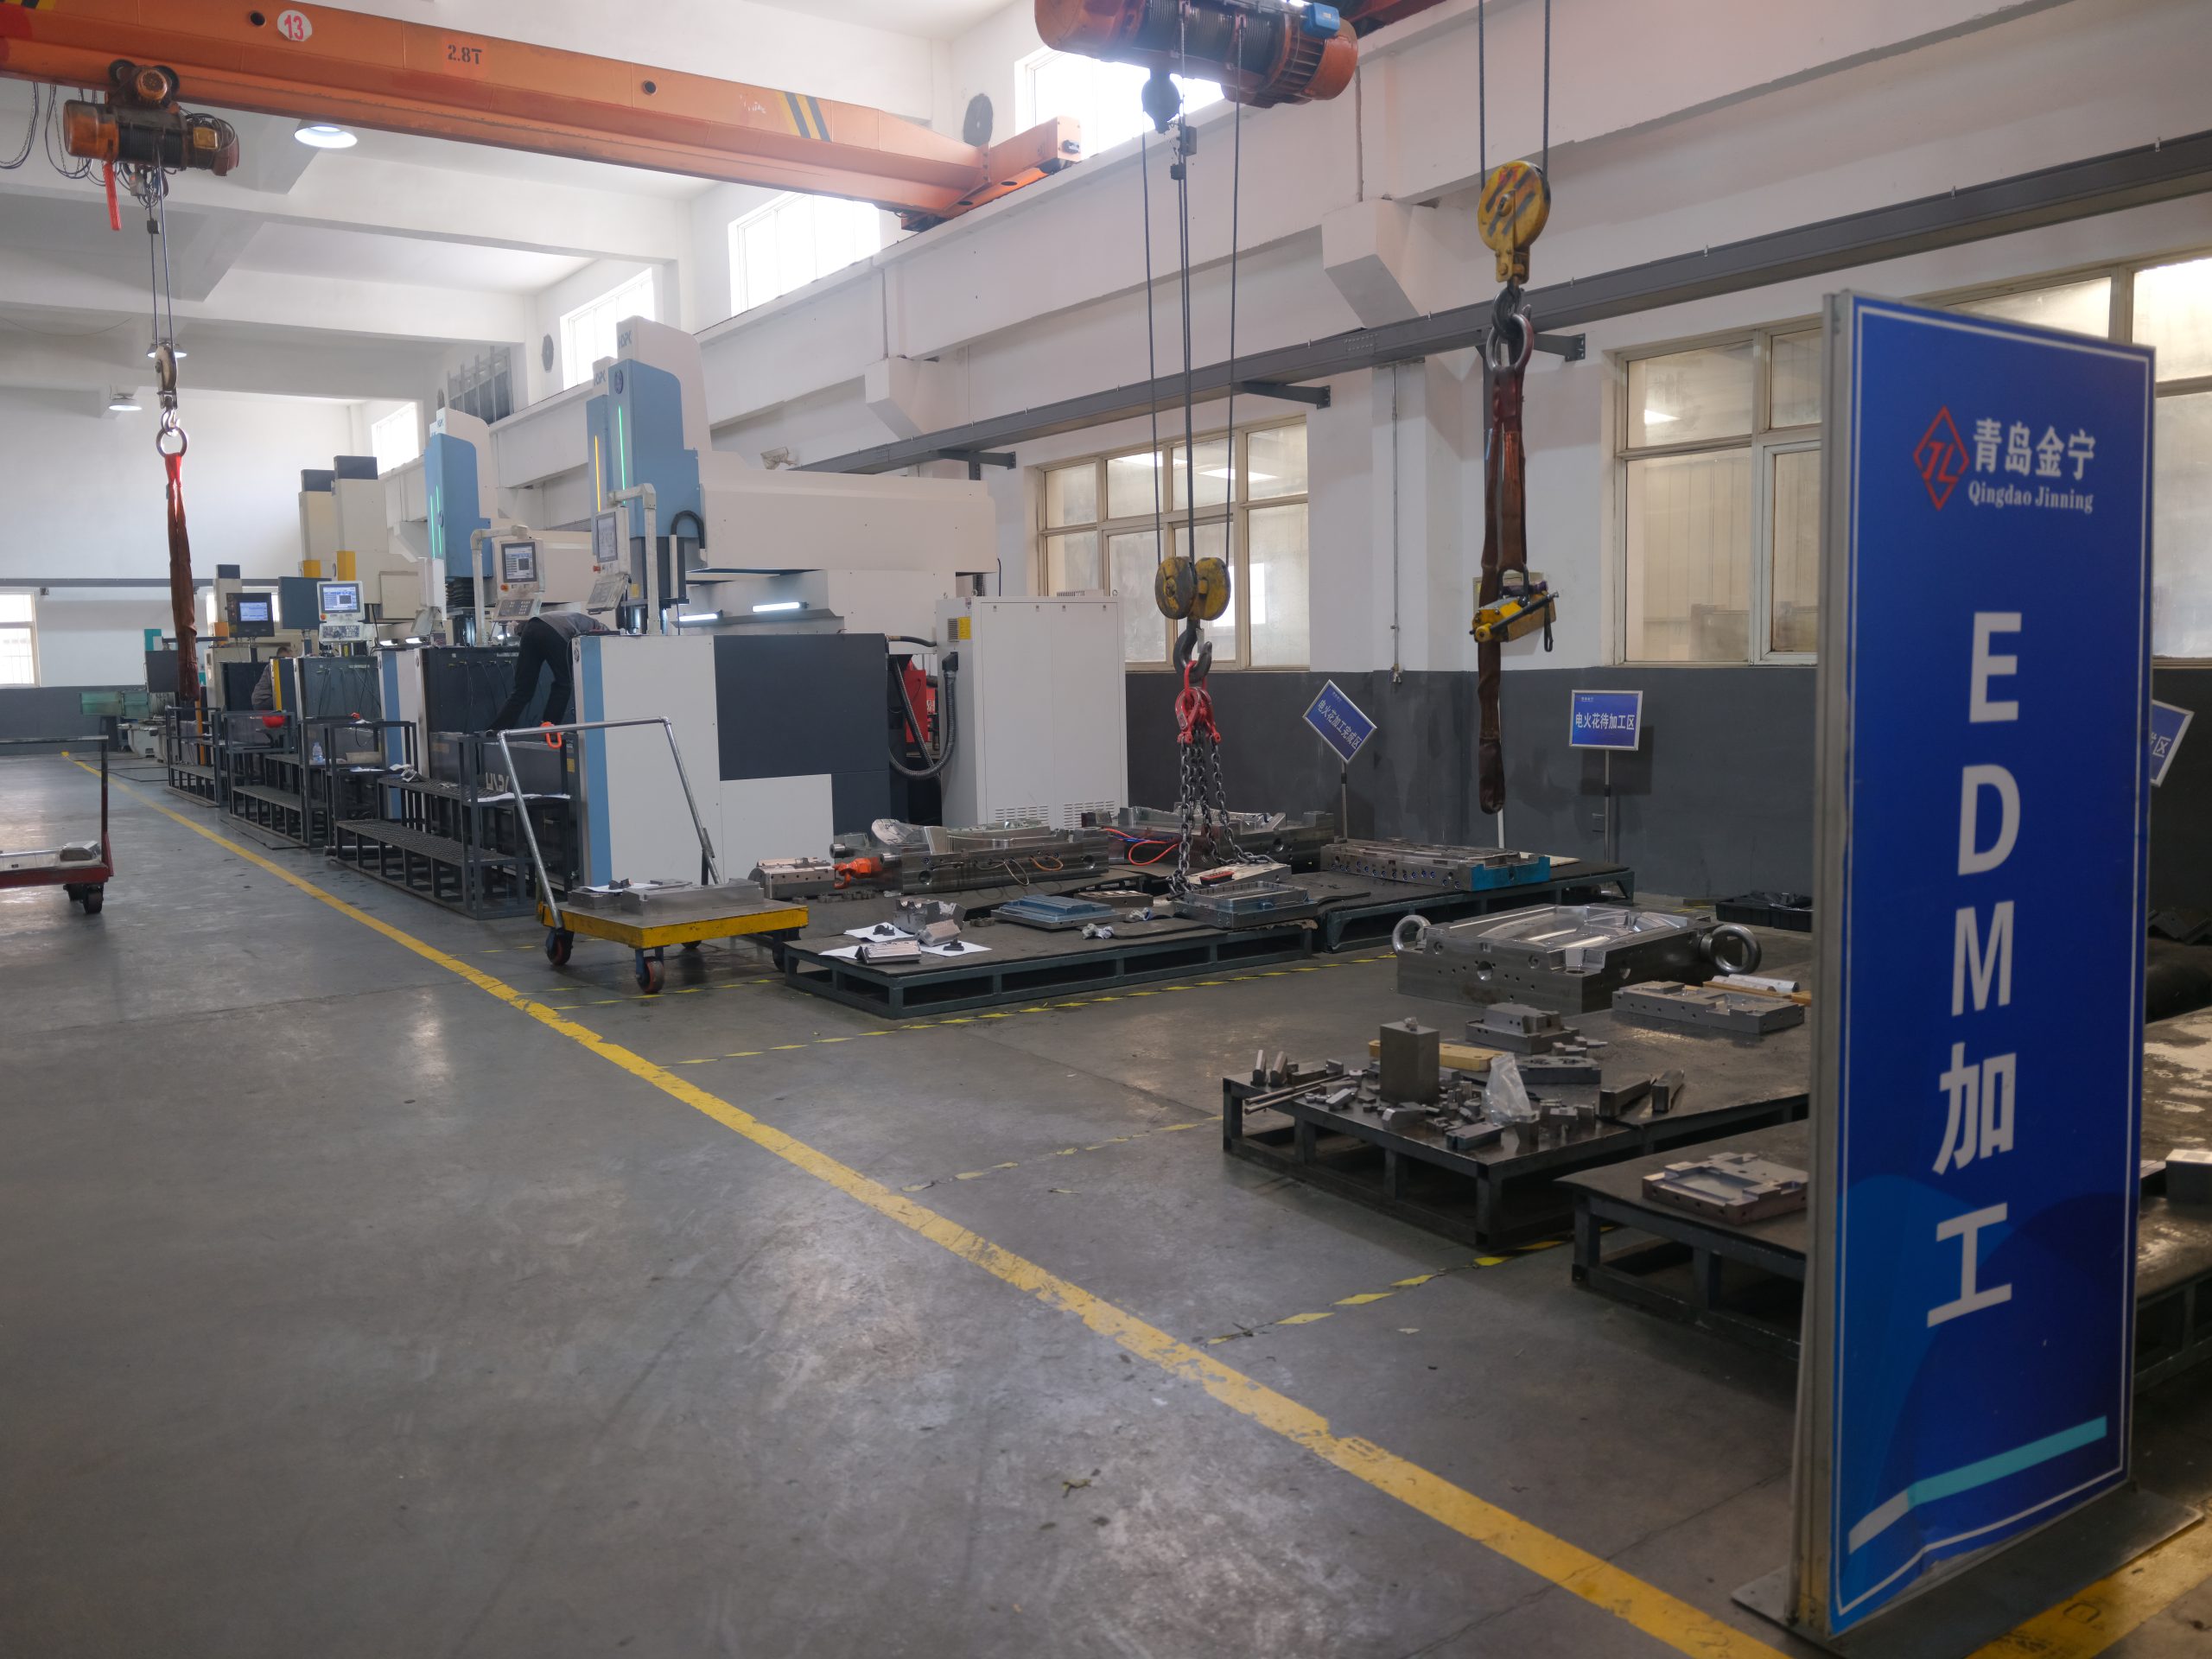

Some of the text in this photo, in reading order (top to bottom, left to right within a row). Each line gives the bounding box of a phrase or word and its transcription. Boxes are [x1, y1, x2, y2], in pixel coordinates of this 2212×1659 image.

[283, 14, 305, 41] 13
[448, 44, 483, 65] 2.8T
[1973, 417, 2096, 480] 青岛金宁
[1968, 480, 2094, 514] Qingdao Jinning
[1317, 699, 1363, 750] 电火花加工完成区
[1575, 713, 1636, 731] 电火花待加工区
